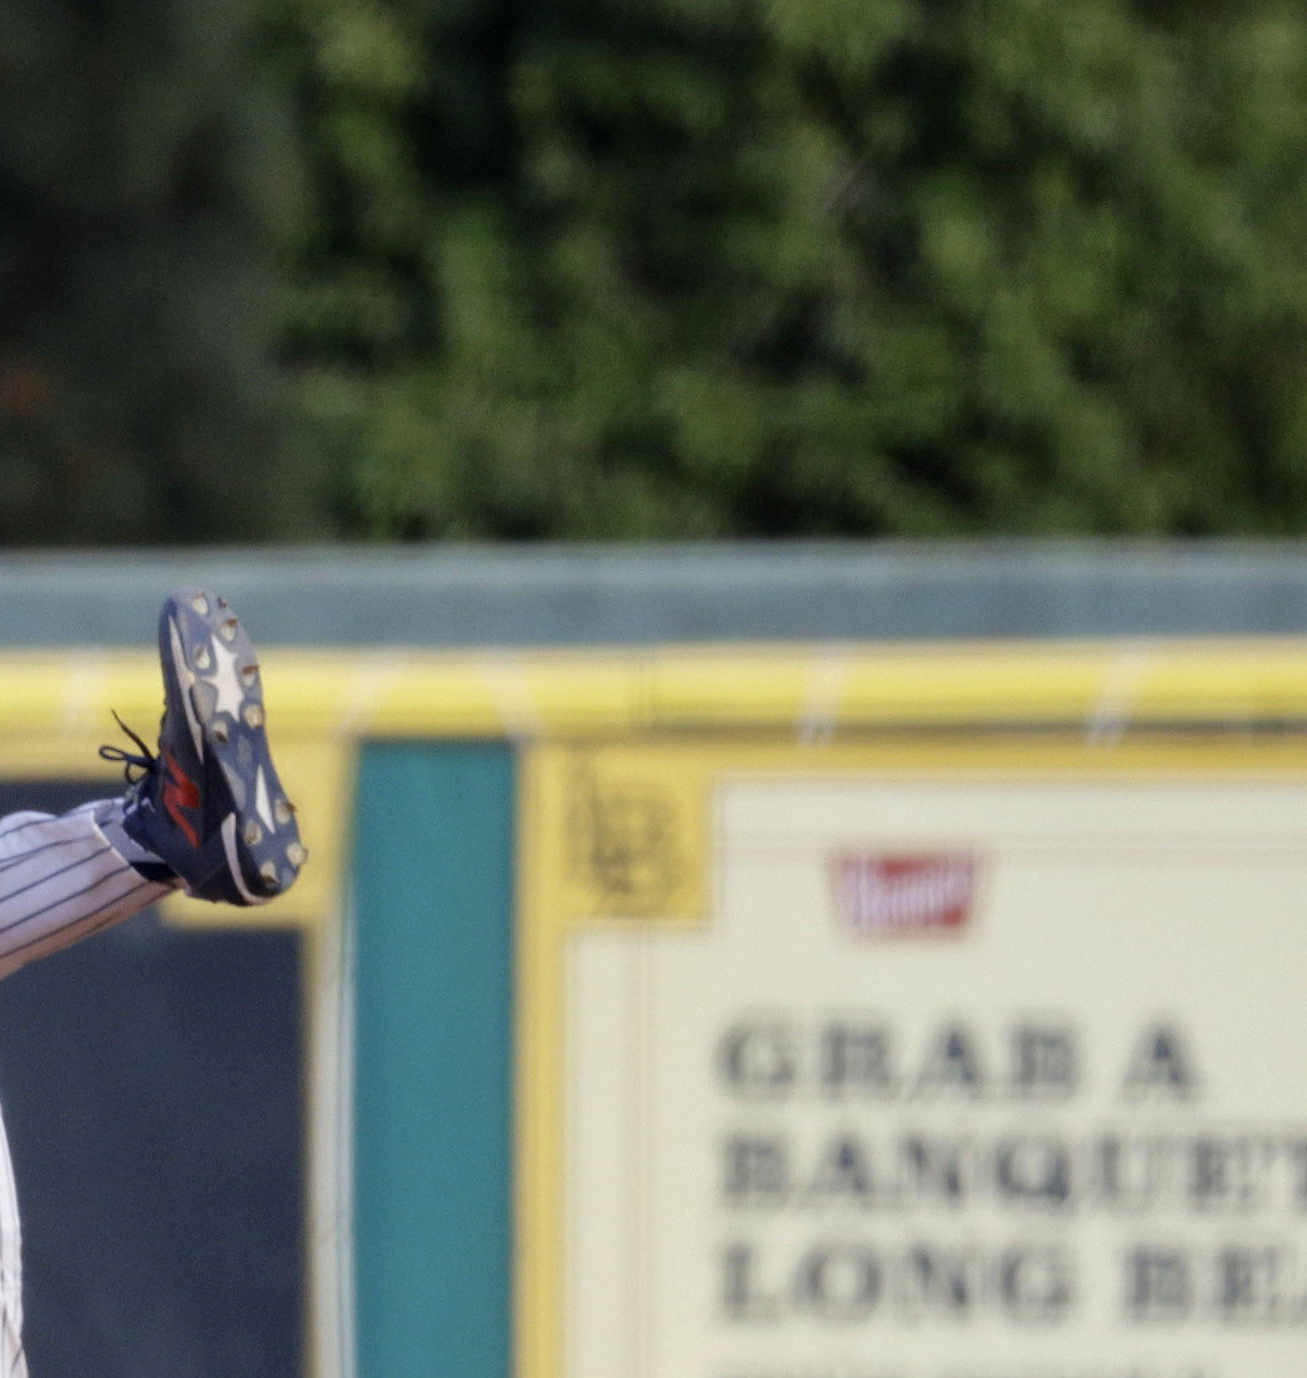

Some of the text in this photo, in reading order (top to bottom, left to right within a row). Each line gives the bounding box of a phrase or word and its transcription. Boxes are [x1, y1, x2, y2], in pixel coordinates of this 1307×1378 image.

[717, 1015, 1199, 1098] GRAB A
[720, 1243, 1307, 1326] LONG BE
